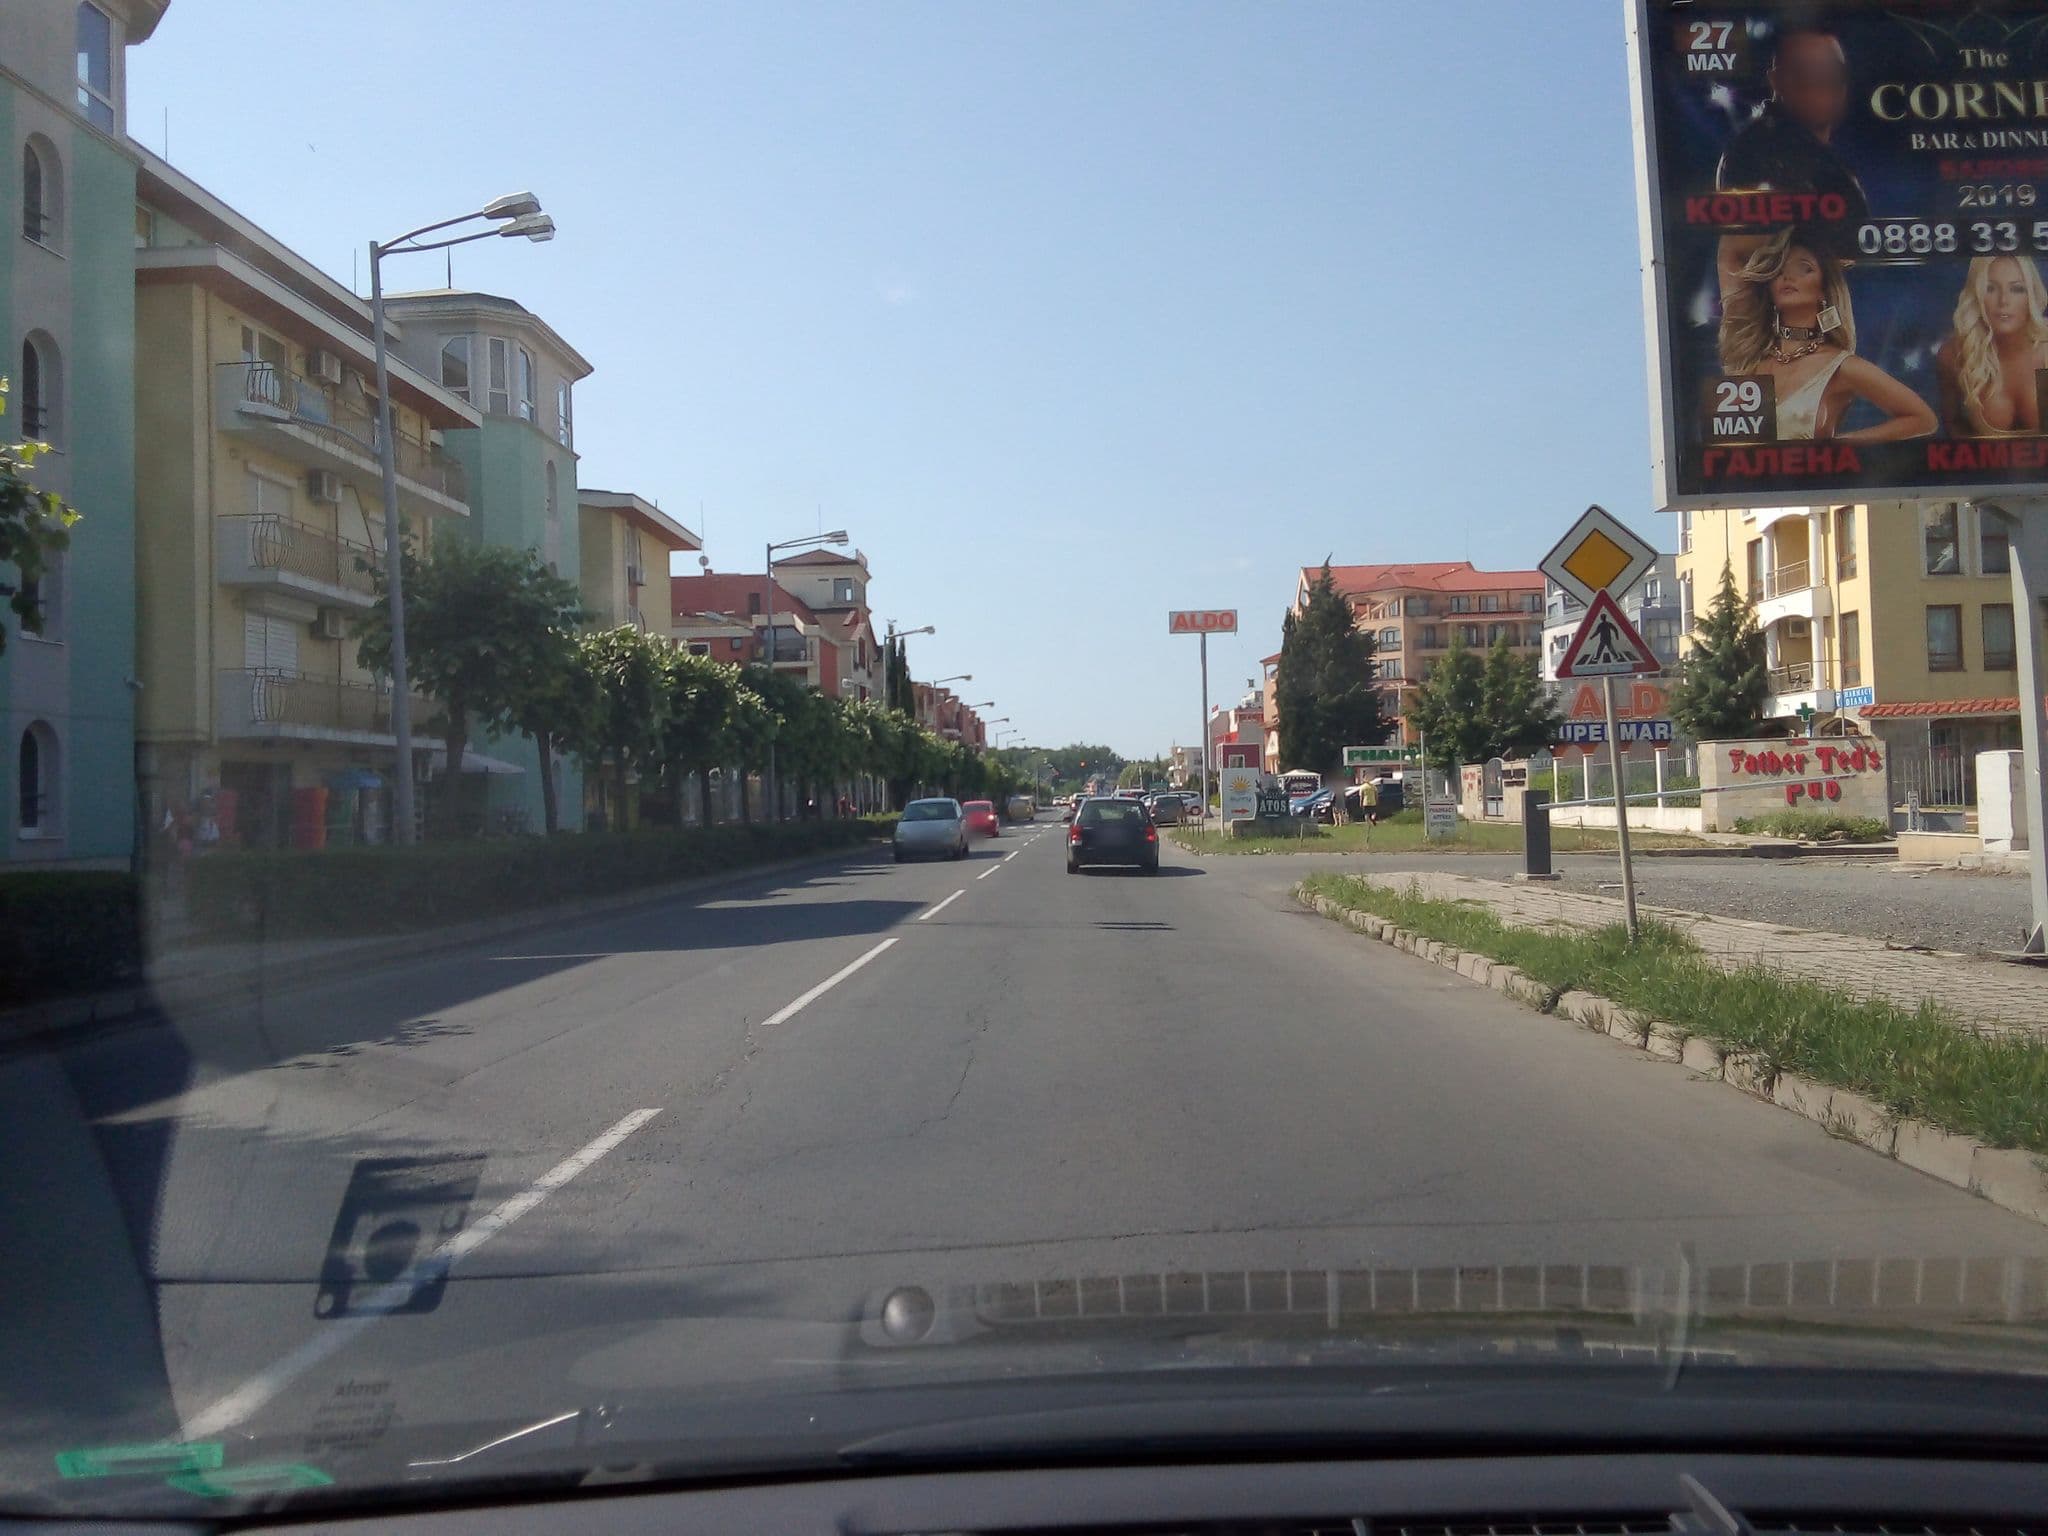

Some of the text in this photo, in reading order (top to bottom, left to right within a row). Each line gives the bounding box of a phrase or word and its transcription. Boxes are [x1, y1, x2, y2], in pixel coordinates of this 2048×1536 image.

[1690, 21, 1734, 49] 27
[1687, 53, 1737, 71] MAY
[1959, 49, 2009, 68] The
[1911, 132, 1960, 150] BAR
[1963, 135, 1977, 148] &
[1958, 184, 2036, 207] 2019
[1686, 193, 1847, 225] КОЦЕТО
[1858, 223, 1958, 253] 0888
[1970, 222, 2019, 252] 33
[1716, 381, 1762, 412] 29
[1713, 416, 1764, 435] MAY
[1702, 446, 1861, 477] ГАЛЕНА
[1173, 612, 1235, 630] ALDO
